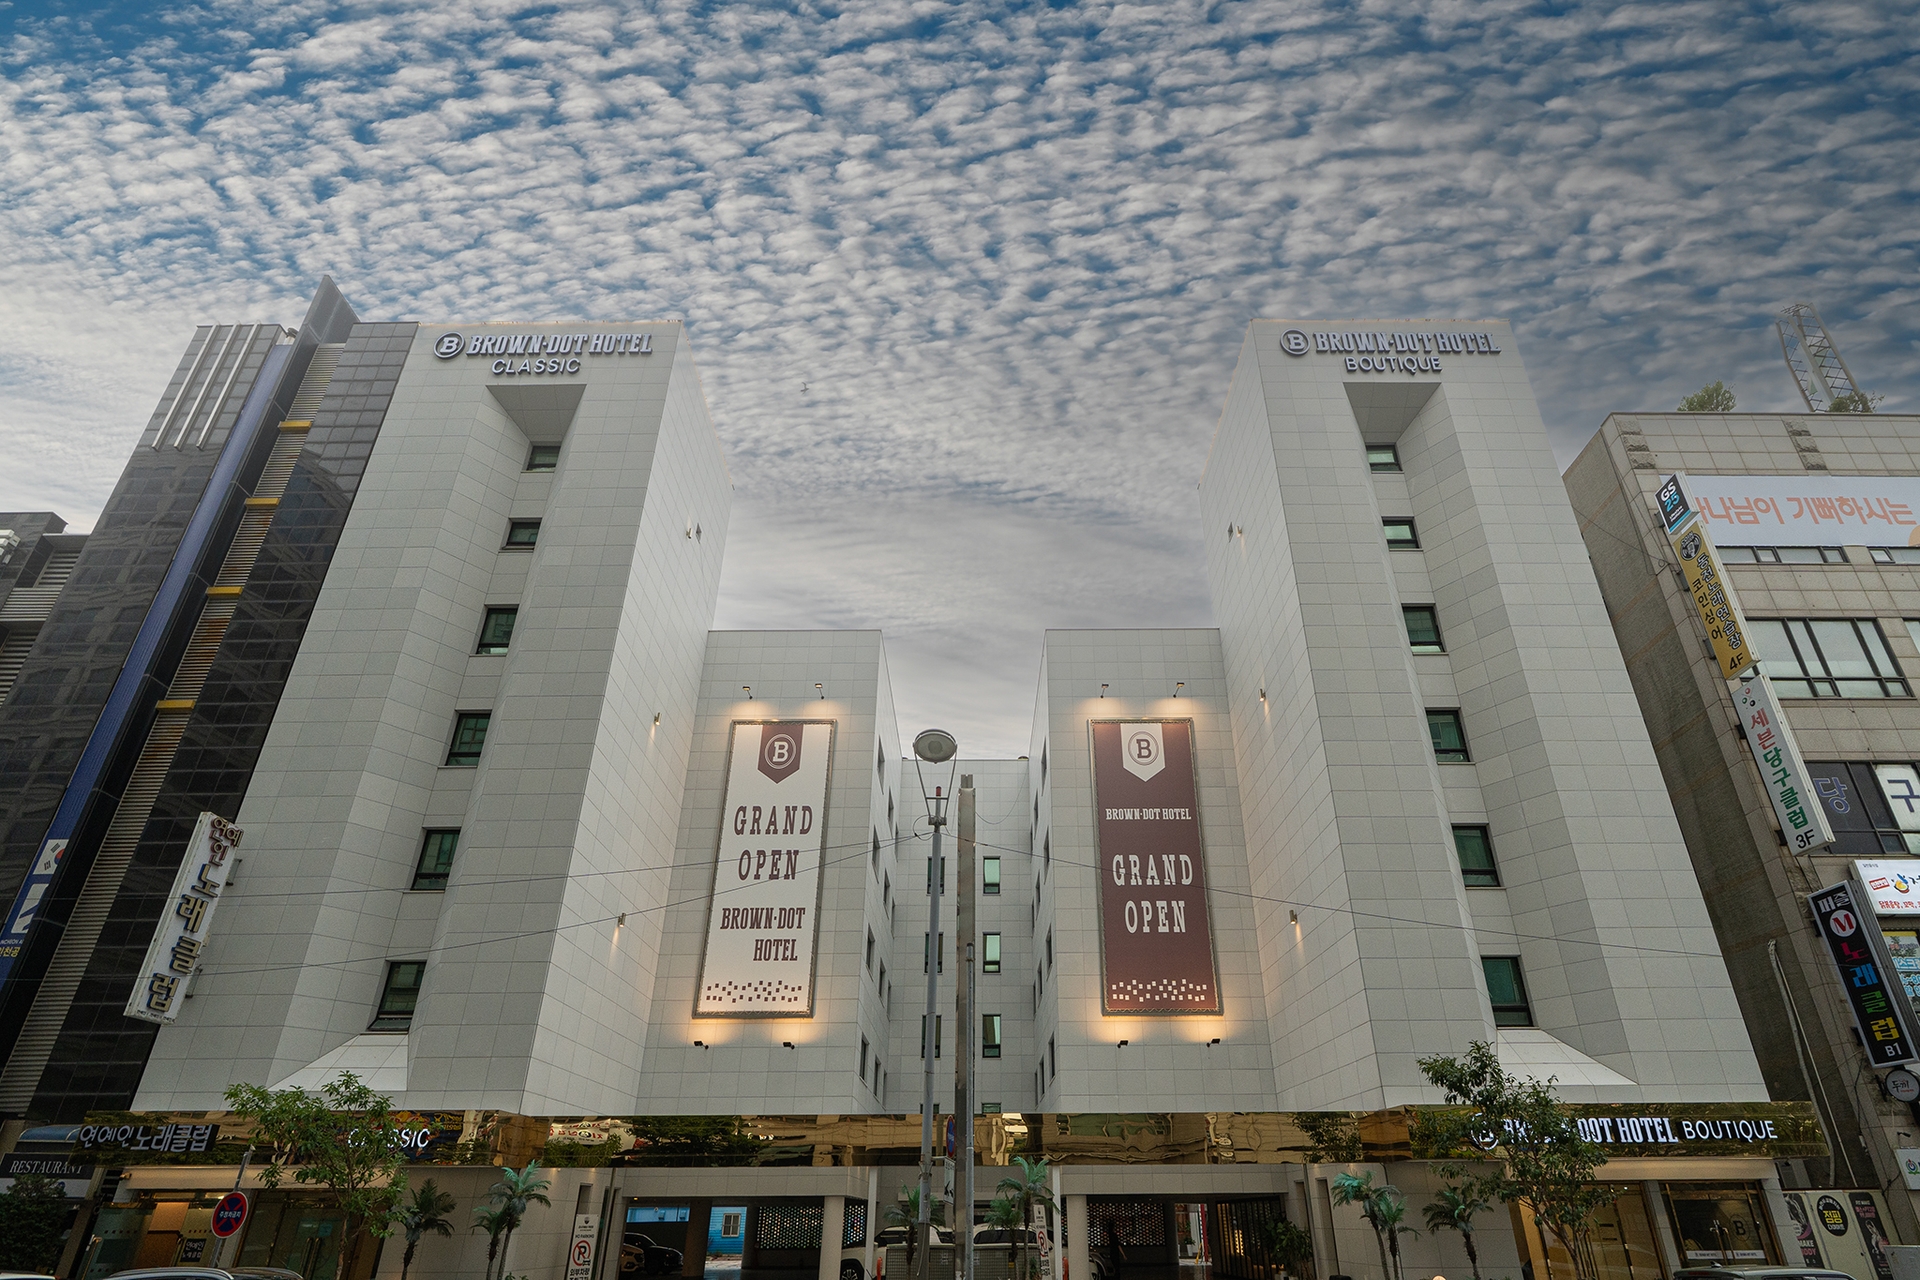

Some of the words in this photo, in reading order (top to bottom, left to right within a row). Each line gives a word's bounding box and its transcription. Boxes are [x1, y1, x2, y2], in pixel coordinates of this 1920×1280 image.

[588, 333, 653, 355] HOTEL
[1434, 332, 1502, 354] HOTEL
[491, 357, 581, 374] CLASSIC
[1344, 356, 1442, 375] BOUTIQUE
[1661, 482, 1676, 502] GS
[1664, 492, 1680, 512] 25
[1786, 496, 1918, 525] 기뻐하시는
[1692, 578, 1724, 641] 코인싱어
[1729, 653, 1744, 671] 4F
[734, 805, 813, 836] GRAND
[1162, 808, 1192, 820] HOTEL
[1795, 829, 1816, 849] 3F
[738, 849, 800, 881] OPEN
[1112, 854, 1193, 886] GRAND
[1816, 890, 1850, 914] 퍼즐
[1125, 900, 1187, 934] OPEN
[1832, 913, 1855, 934] M
[753, 939, 798, 961] HOTEL
[1884, 1042, 1902, 1058] B1
[1614, 1117, 1679, 1143] HOTEL
[1681, 1120, 1778, 1143] BOUTIQUE
[1733, 1220, 1746, 1236] B
